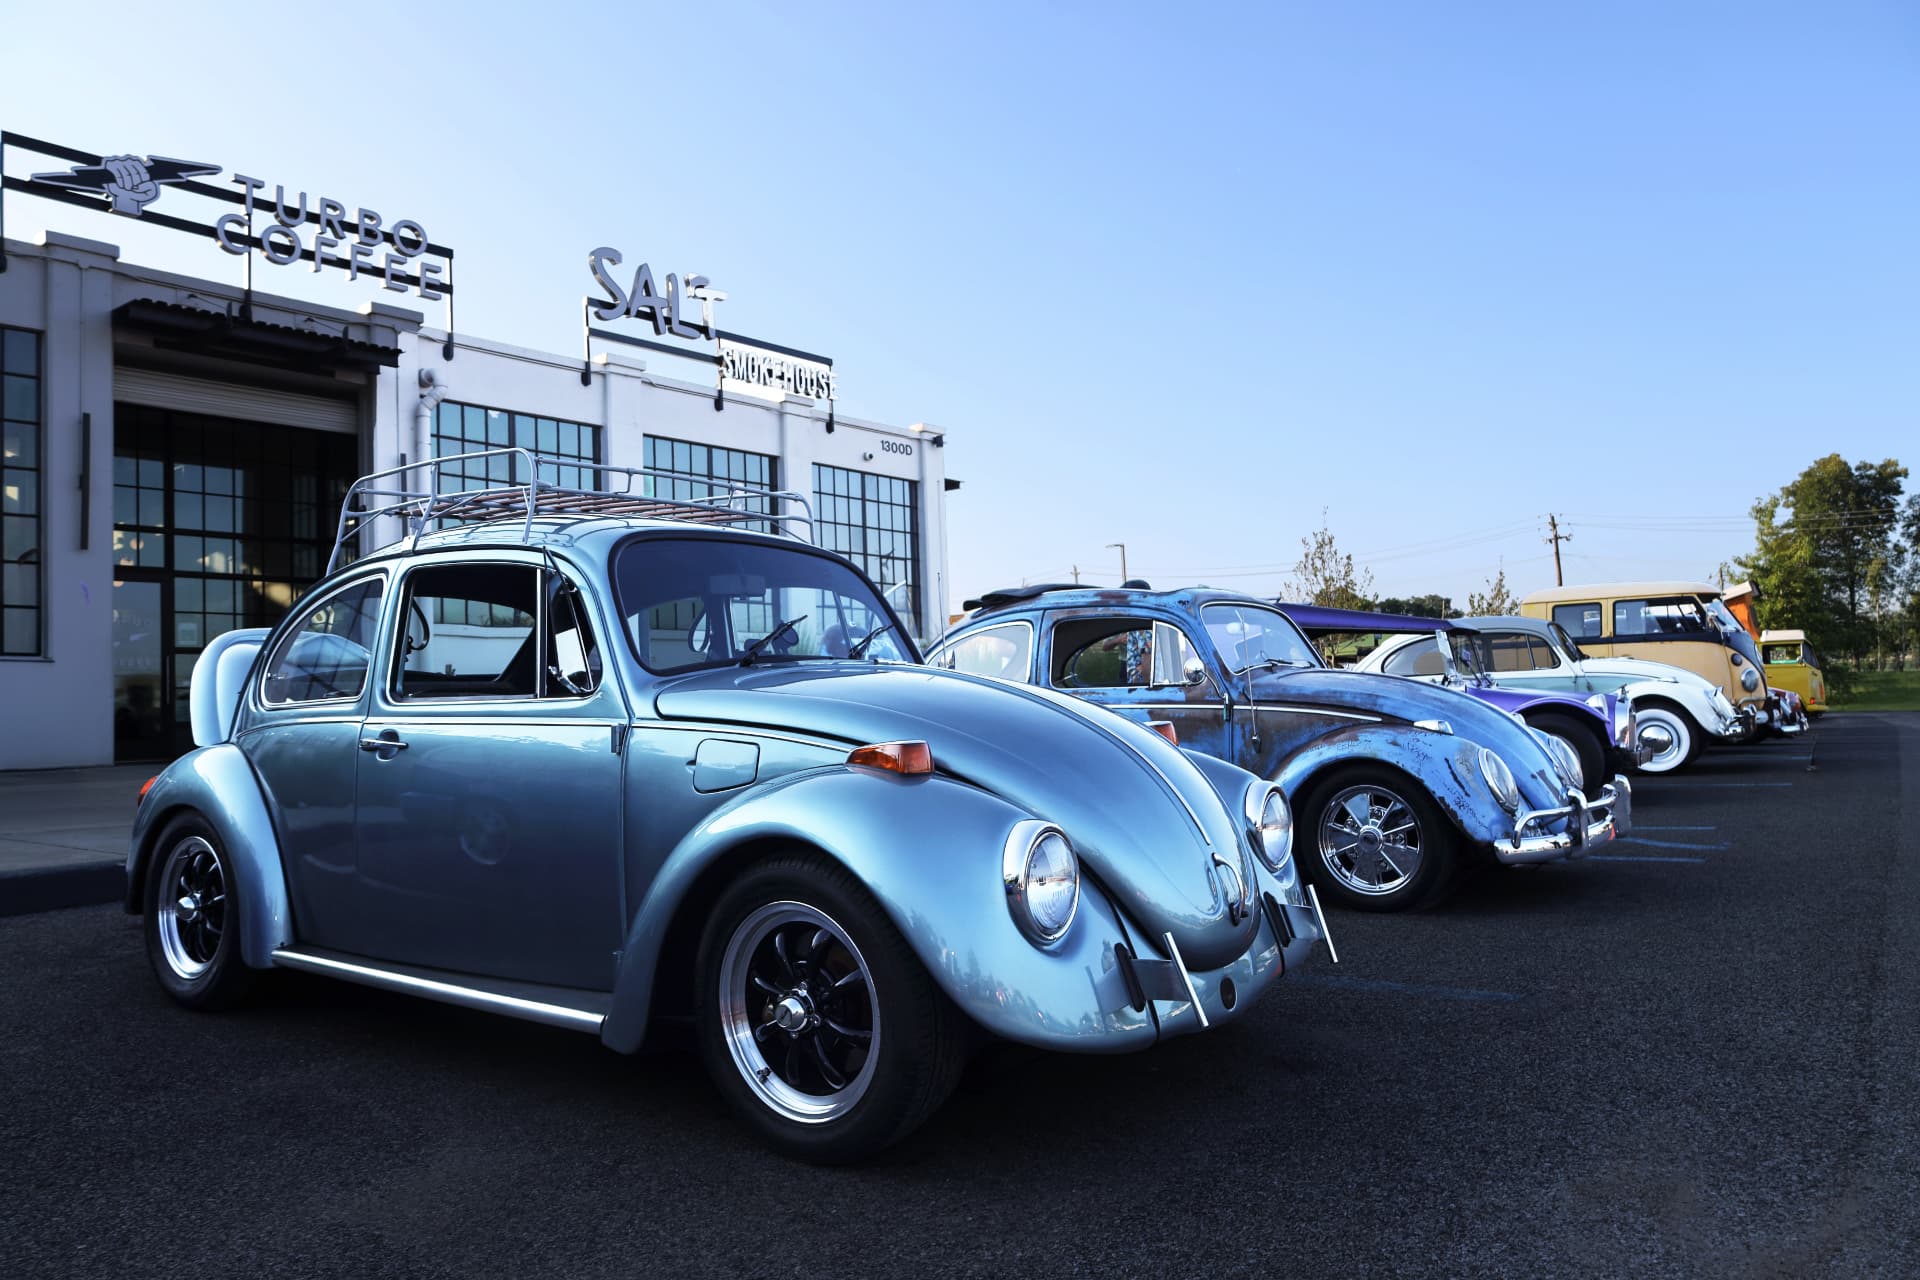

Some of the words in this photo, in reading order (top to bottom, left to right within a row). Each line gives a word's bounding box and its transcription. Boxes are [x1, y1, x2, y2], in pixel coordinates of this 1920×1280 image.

[216, 213, 442, 301] COFFEE
[232, 173, 428, 257] TURBO
[588, 246, 729, 341] SALT
[722, 347, 838, 401] SMOKEHOUSE
[880, 439, 913, 456] 1300D
